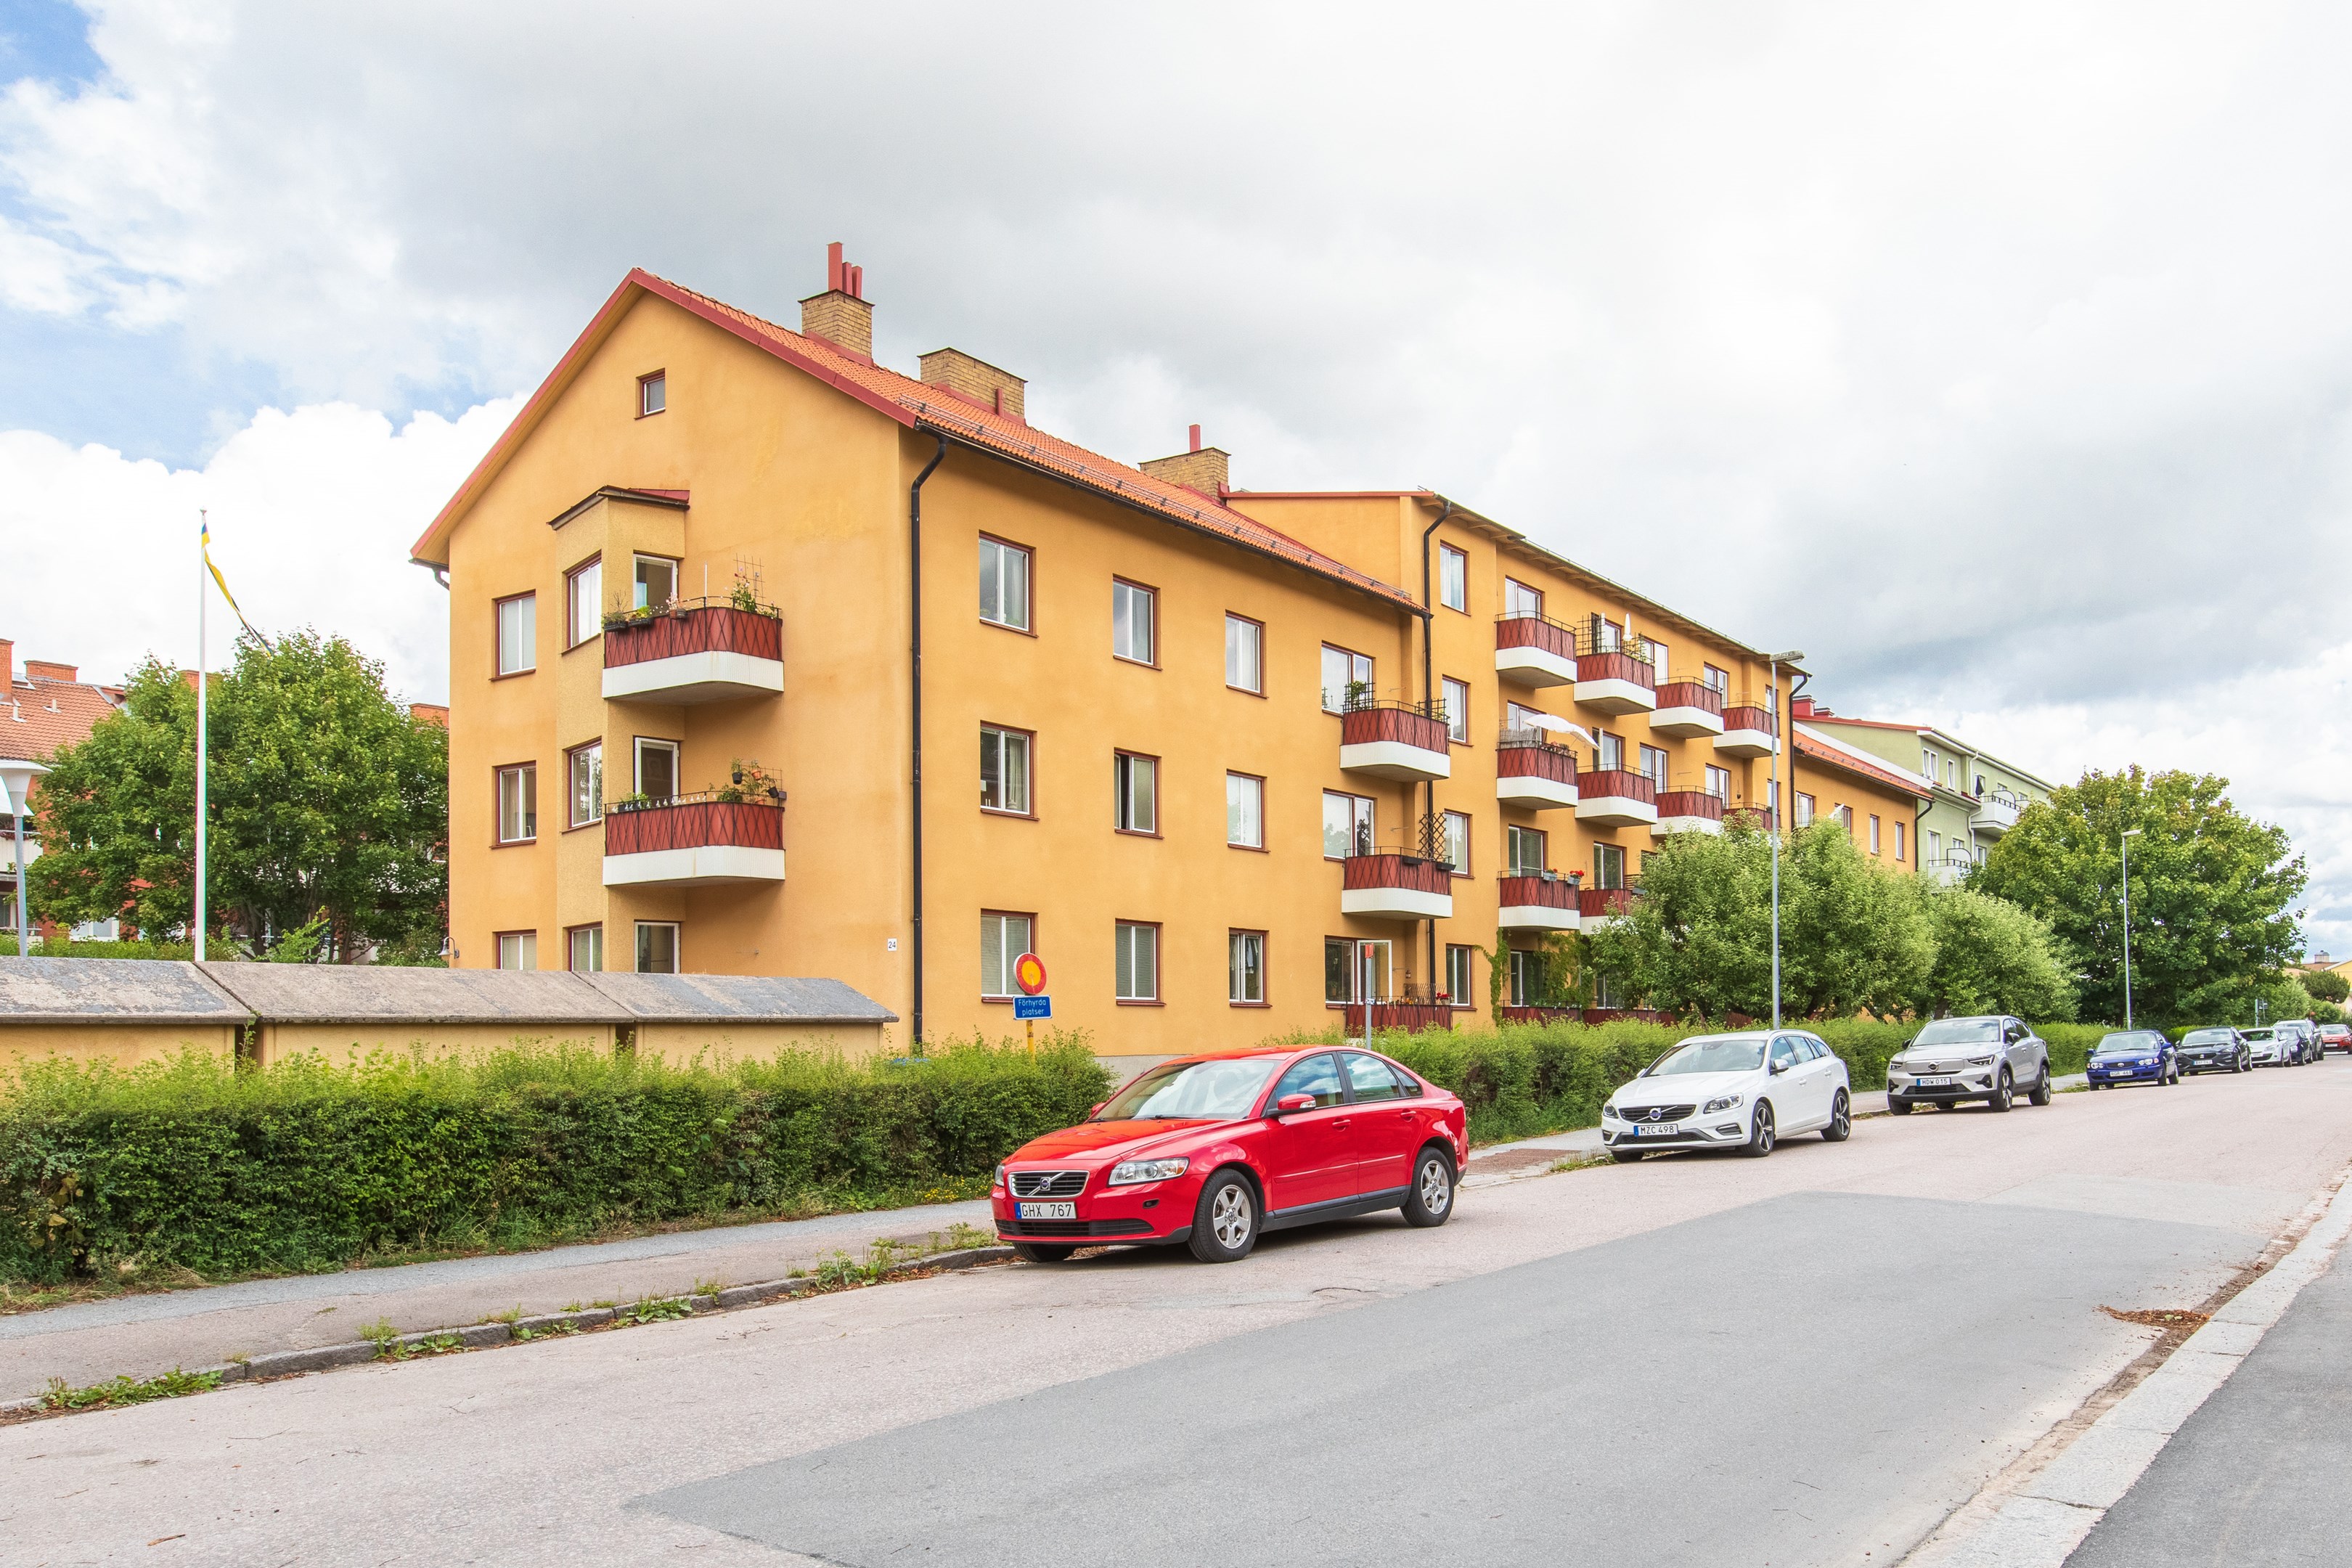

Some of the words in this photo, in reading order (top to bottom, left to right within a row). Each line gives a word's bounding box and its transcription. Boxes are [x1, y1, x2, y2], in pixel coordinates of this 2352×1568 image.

[1018, 998, 1046, 1008] Förhyrda
[1022, 1008, 1045, 1017] platser
[1021, 1204, 1042, 1217] GHX
[1050, 1204, 1071, 1217] 767
